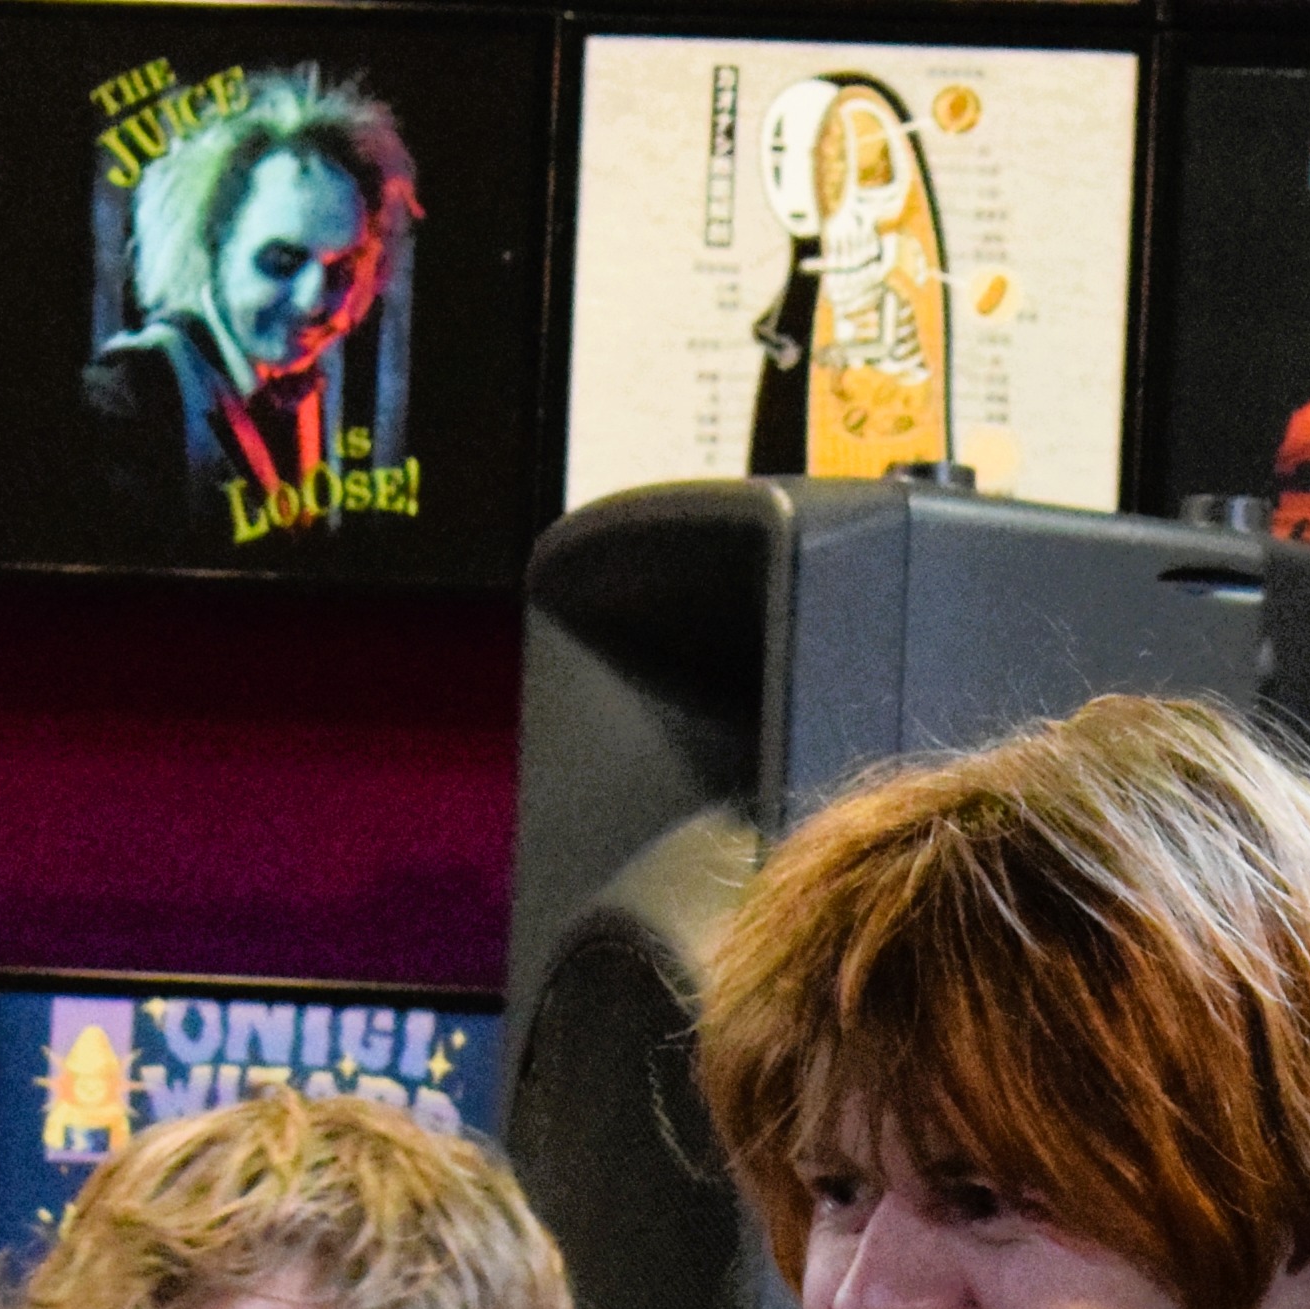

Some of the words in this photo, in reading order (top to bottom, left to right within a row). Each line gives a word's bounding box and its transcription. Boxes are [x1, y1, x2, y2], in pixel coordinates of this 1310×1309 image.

[91, 57, 176, 117] THE
[97, 66, 251, 188] JUICE
[164, 1000, 435, 1079] ONIGI
